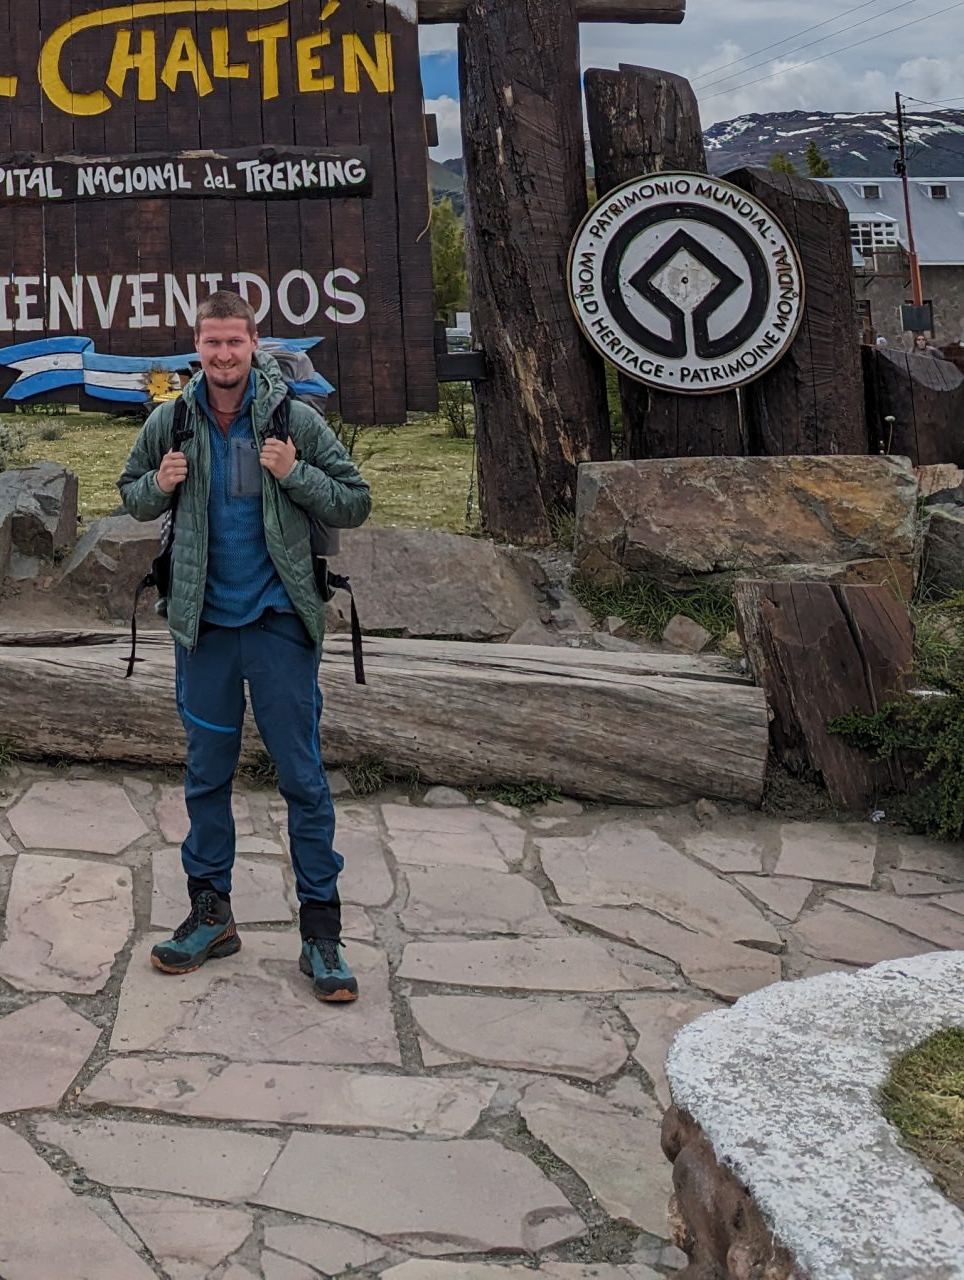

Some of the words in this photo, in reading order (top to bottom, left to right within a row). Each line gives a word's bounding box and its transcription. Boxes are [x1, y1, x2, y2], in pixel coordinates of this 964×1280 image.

[76, 162, 192, 197] NACIONAL
[236, 157, 368, 194] TREKKING
[589, 179, 691, 240] PATRIMONIO
[694, 181, 775, 240] MUNDIAL
[578, 252, 600, 316] WORLD
[591, 316, 665, 379] HERITAGE
[679, 330, 781, 384] PATRIMOINE
[771, 244, 796, 333] MONDIAL
